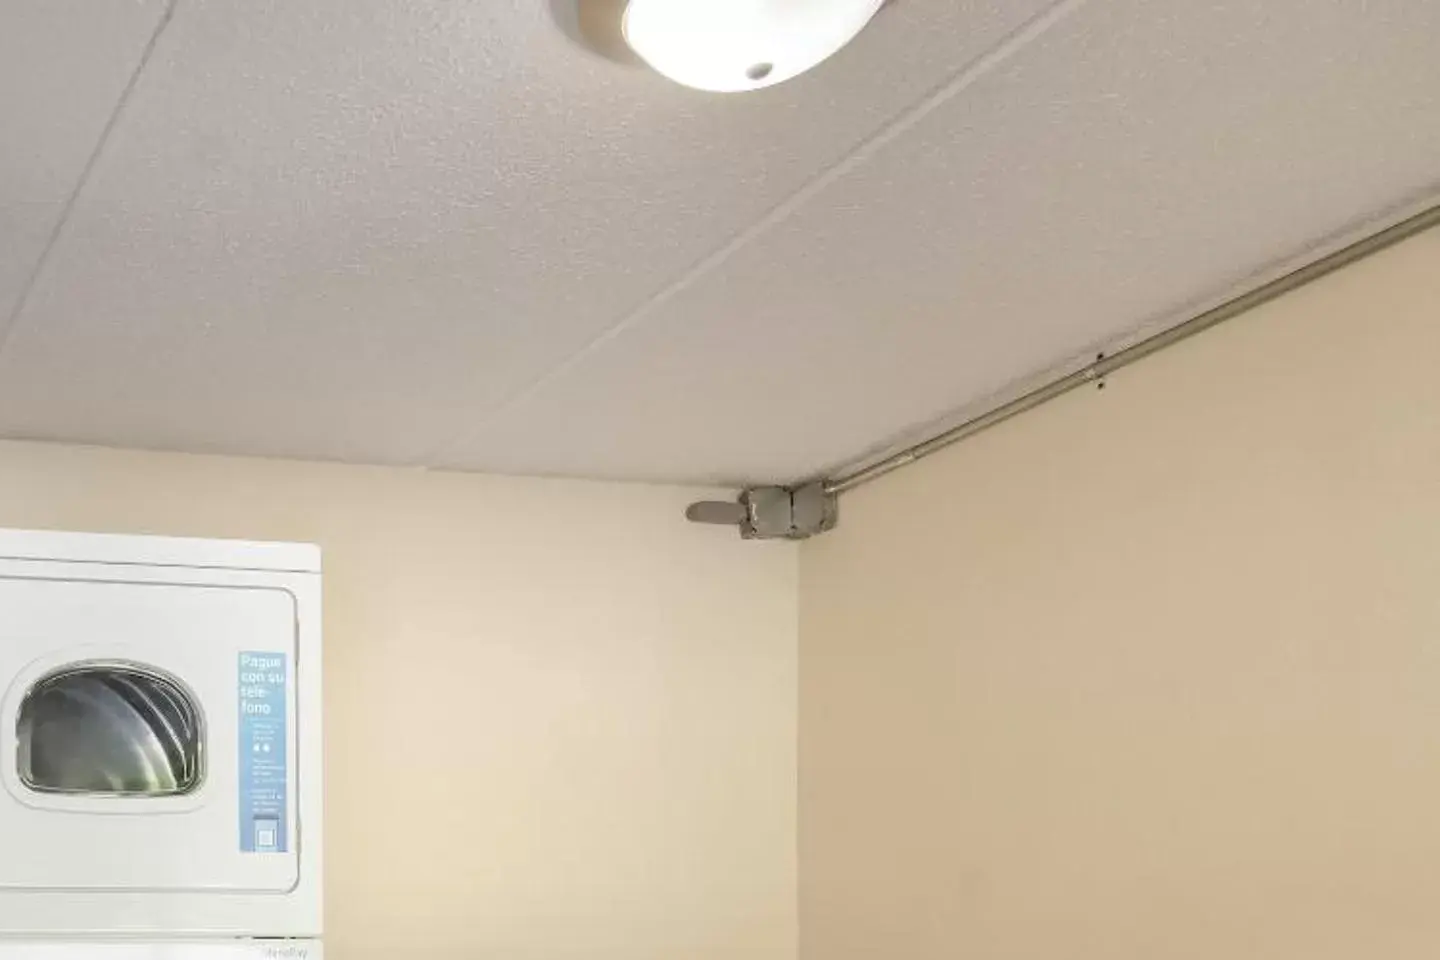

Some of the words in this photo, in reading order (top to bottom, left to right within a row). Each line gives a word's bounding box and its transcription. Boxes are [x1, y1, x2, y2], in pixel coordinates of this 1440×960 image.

[240, 654, 281, 671] Pague
[240, 673, 265, 684] con
[267, 673, 284, 684] su
[241, 701, 272, 715] fono
